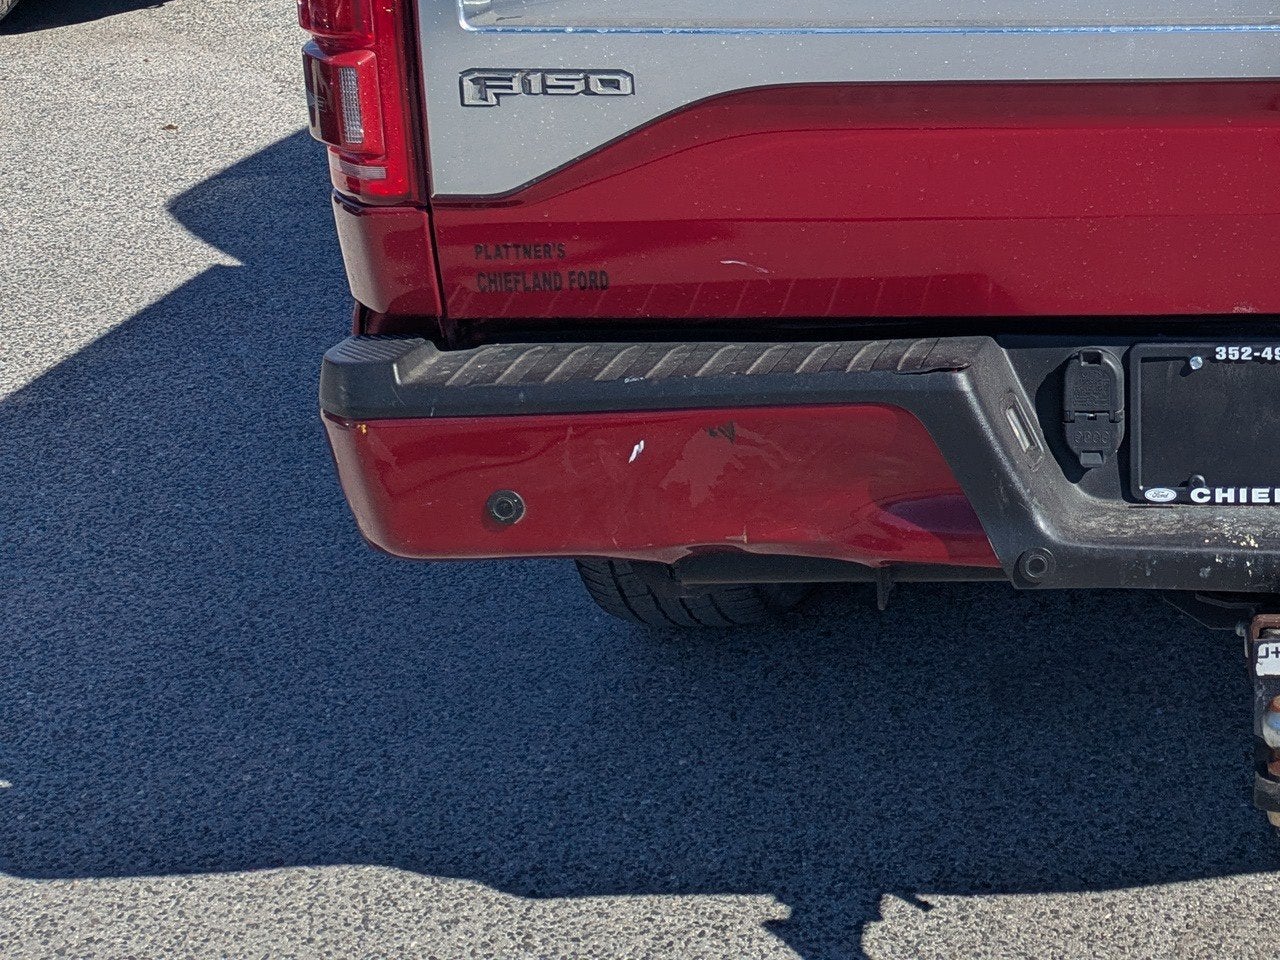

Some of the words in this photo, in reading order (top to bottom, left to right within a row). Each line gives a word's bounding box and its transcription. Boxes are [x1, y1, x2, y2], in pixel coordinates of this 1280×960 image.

[473, 243, 567, 260] PLATTNER'S
[475, 270, 563, 292] CHIEFLAND
[567, 270, 610, 291] FORD
